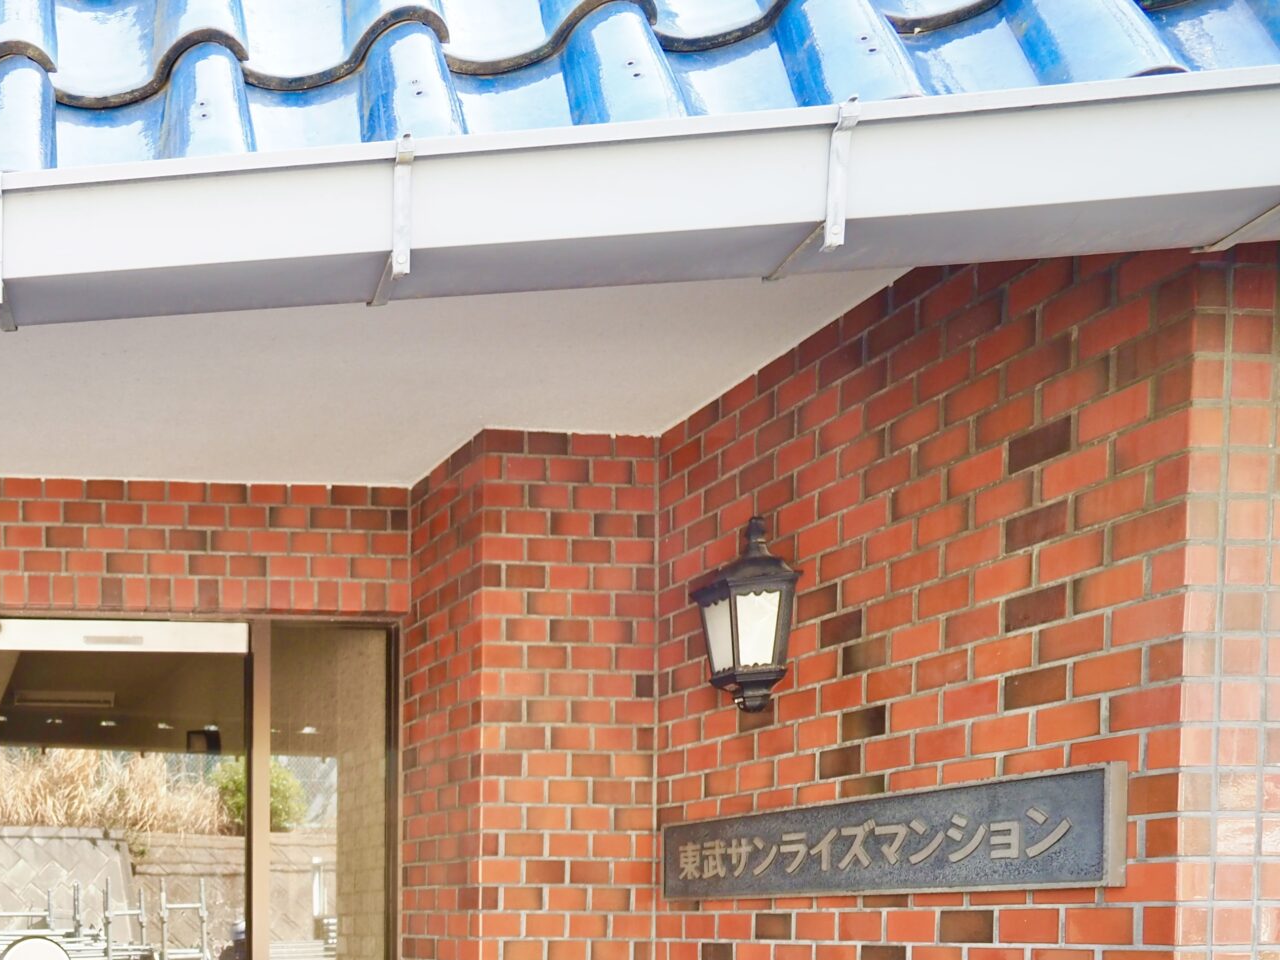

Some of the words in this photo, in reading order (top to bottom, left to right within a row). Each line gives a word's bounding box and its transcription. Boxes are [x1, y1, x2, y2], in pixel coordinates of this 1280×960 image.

[678, 807, 1073, 881] 東武サンライズマンション
